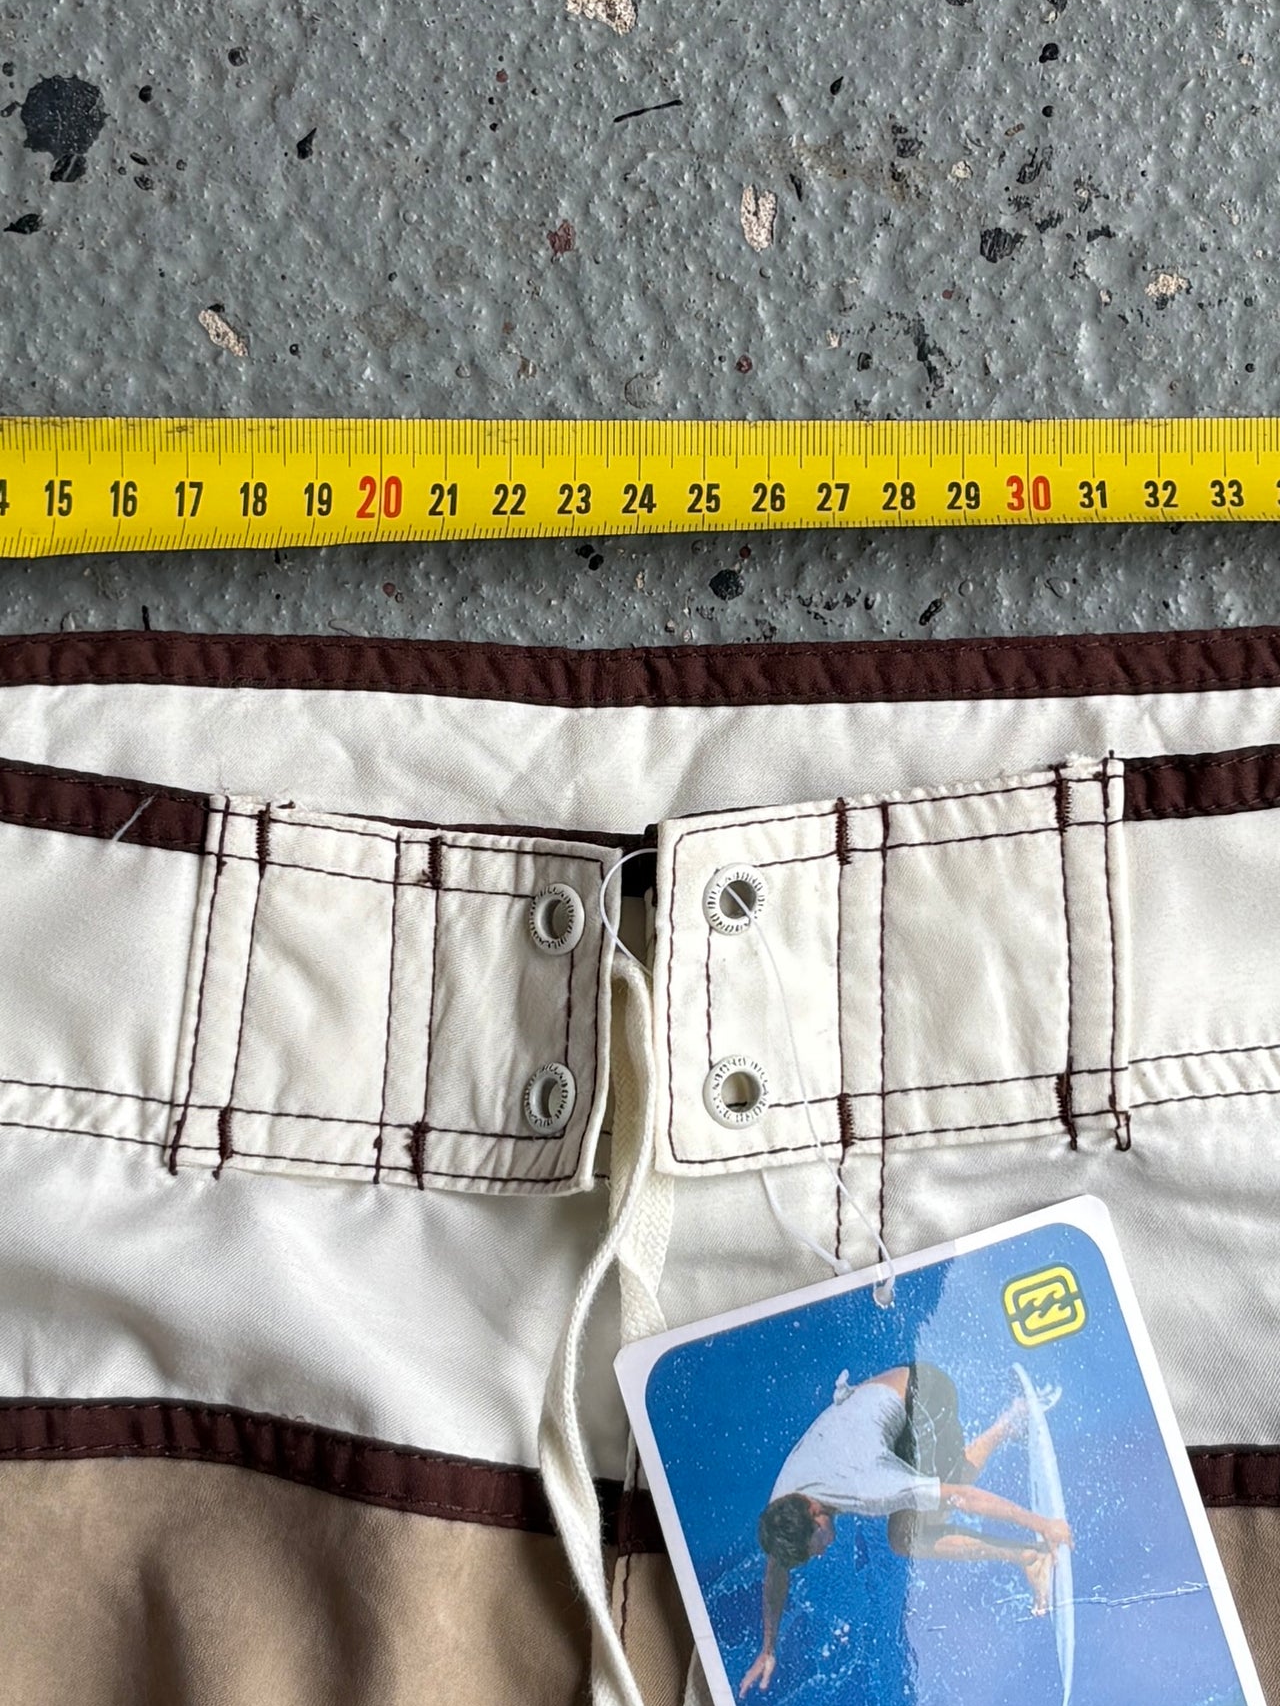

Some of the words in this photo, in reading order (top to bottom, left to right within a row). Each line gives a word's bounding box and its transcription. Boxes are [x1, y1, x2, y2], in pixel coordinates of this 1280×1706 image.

[44, 479, 72, 517] 15
[110, 480, 137, 517] 16
[175, 481, 203, 517] 17
[240, 481, 267, 517] 18
[304, 482, 332, 517] 19
[356, 475, 402, 519] 20
[428, 483, 458, 516] 21
[492, 483, 526, 516] 22
[557, 483, 592, 515] 23
[621, 483, 657, 514] 24
[687, 483, 721, 513] 25
[751, 482, 786, 512] 26
[816, 482, 850, 512] 27
[882, 481, 916, 511] 28
[947, 481, 981, 510] 29
[1006, 475, 1052, 511] 30
[1078, 480, 1108, 509] 31
[1144, 480, 1178, 508] 32
[1210, 479, 1244, 508] 33
